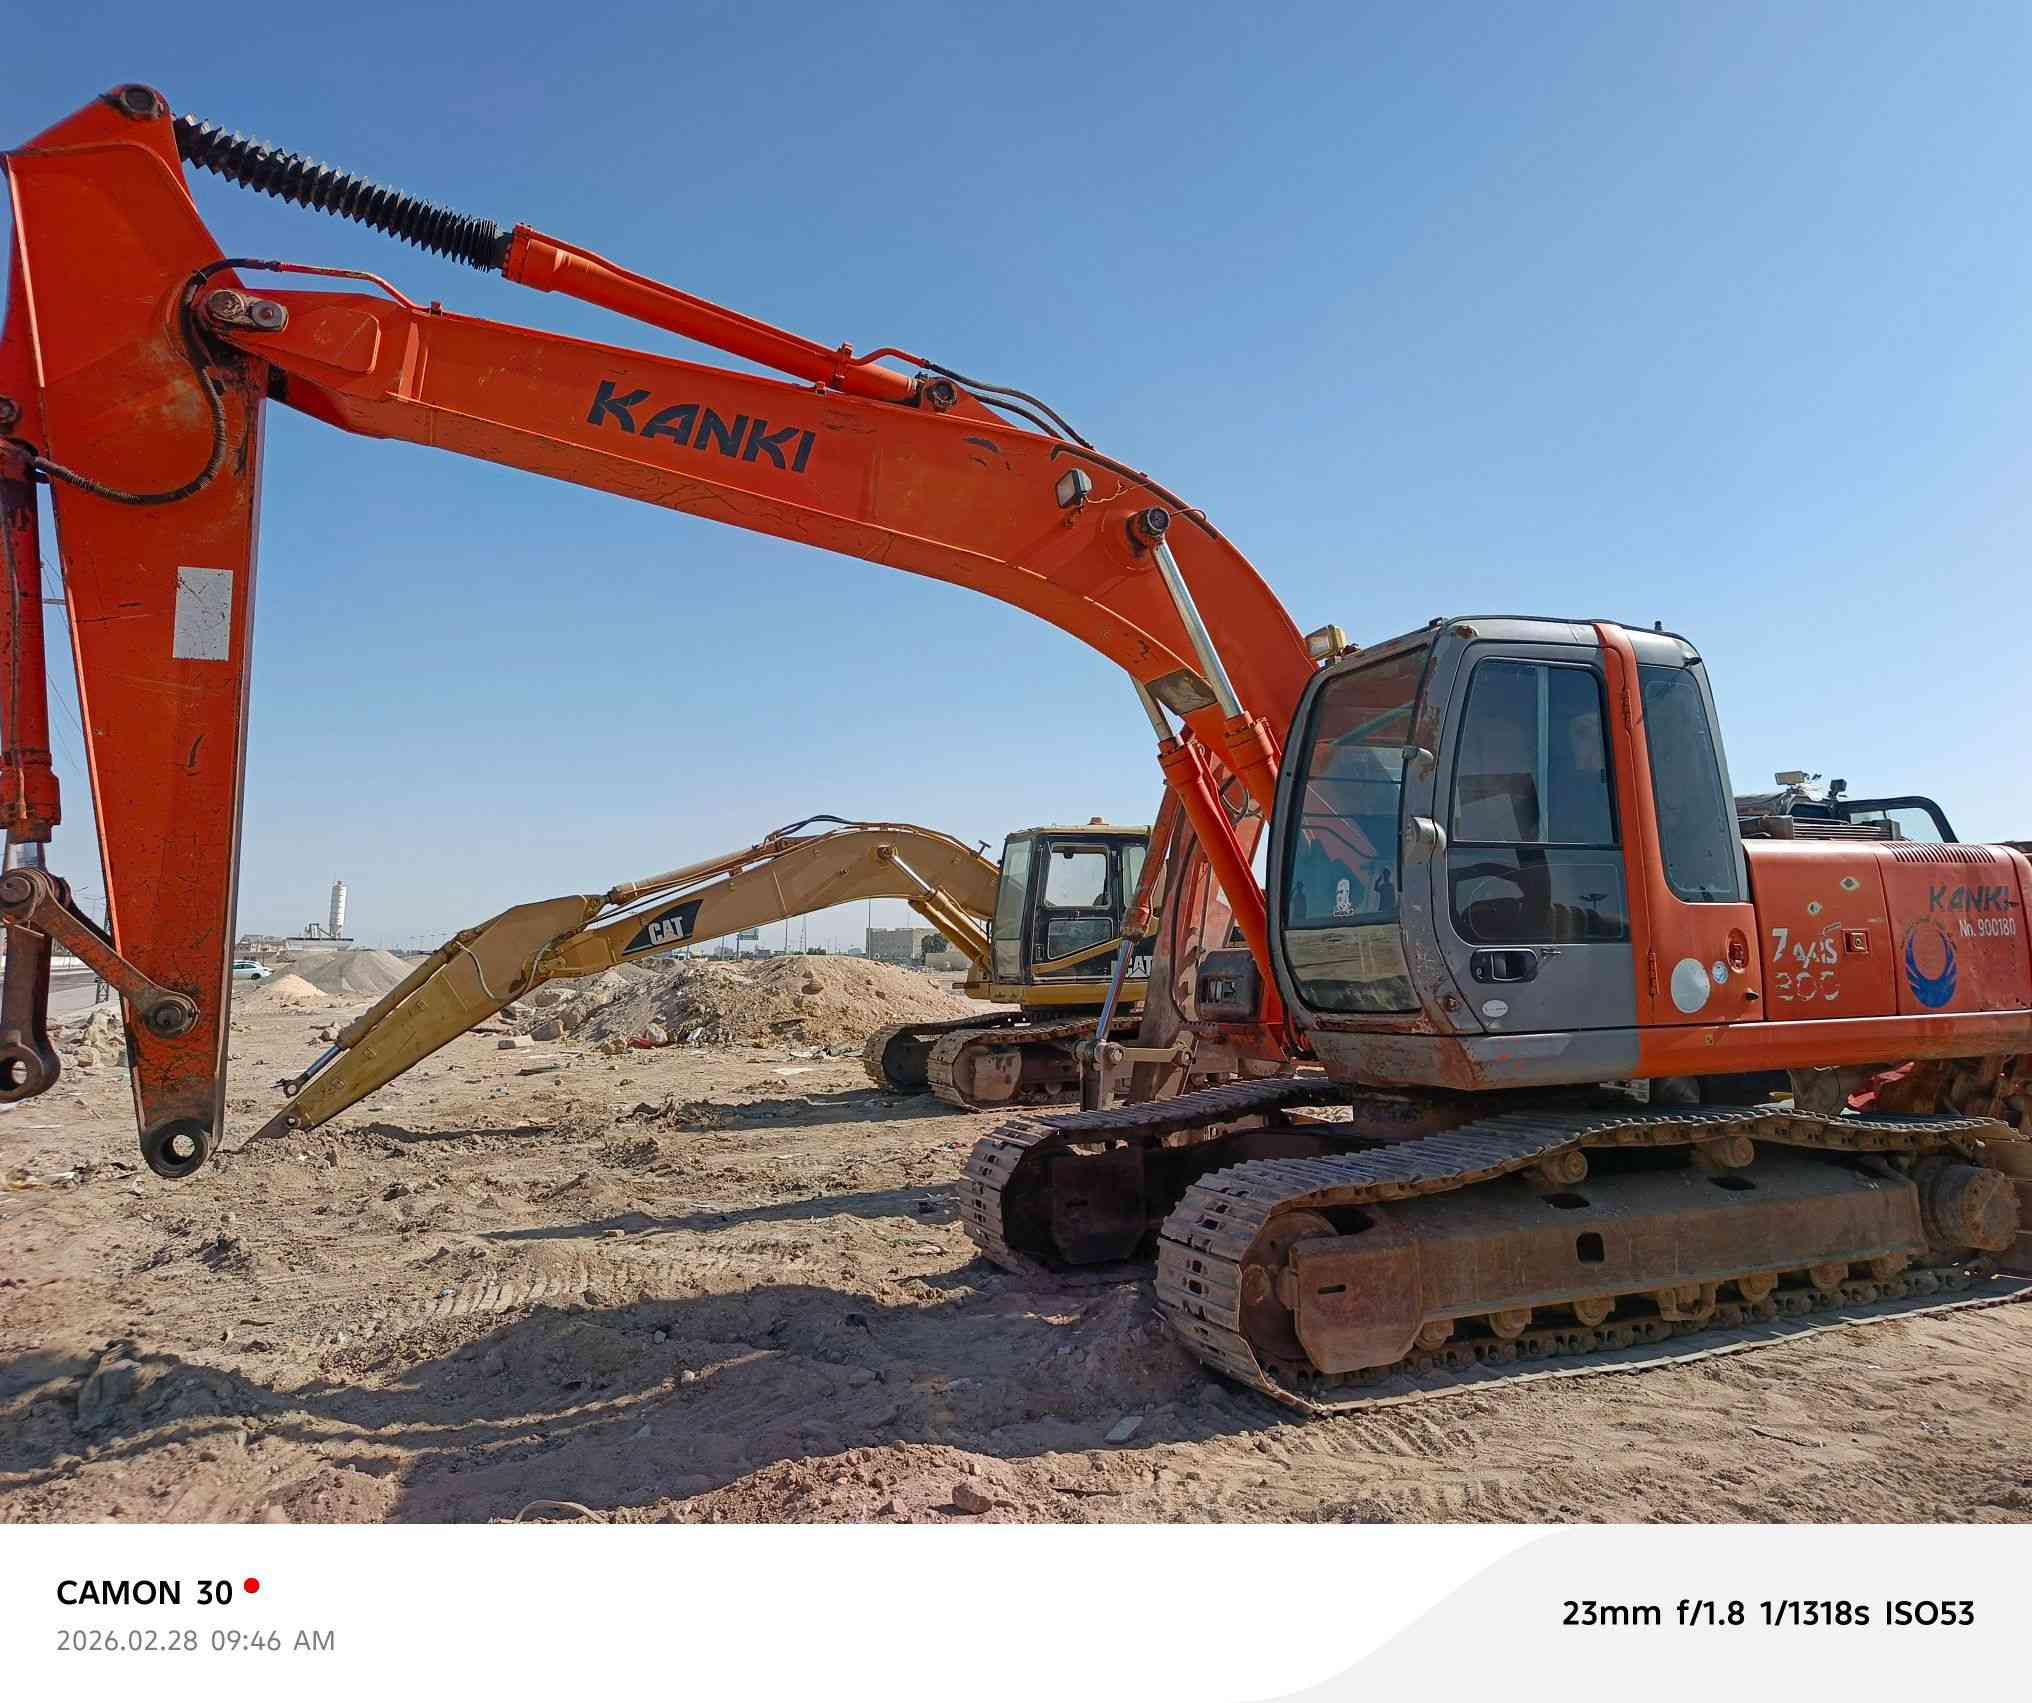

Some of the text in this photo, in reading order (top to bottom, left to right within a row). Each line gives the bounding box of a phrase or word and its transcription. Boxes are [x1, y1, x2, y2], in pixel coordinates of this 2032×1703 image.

[586, 379, 816, 473] KANKI
[1929, 885, 2009, 912] KANKI
[648, 916, 683, 945] CAT
[1978, 918, 2016, 937] 900180
